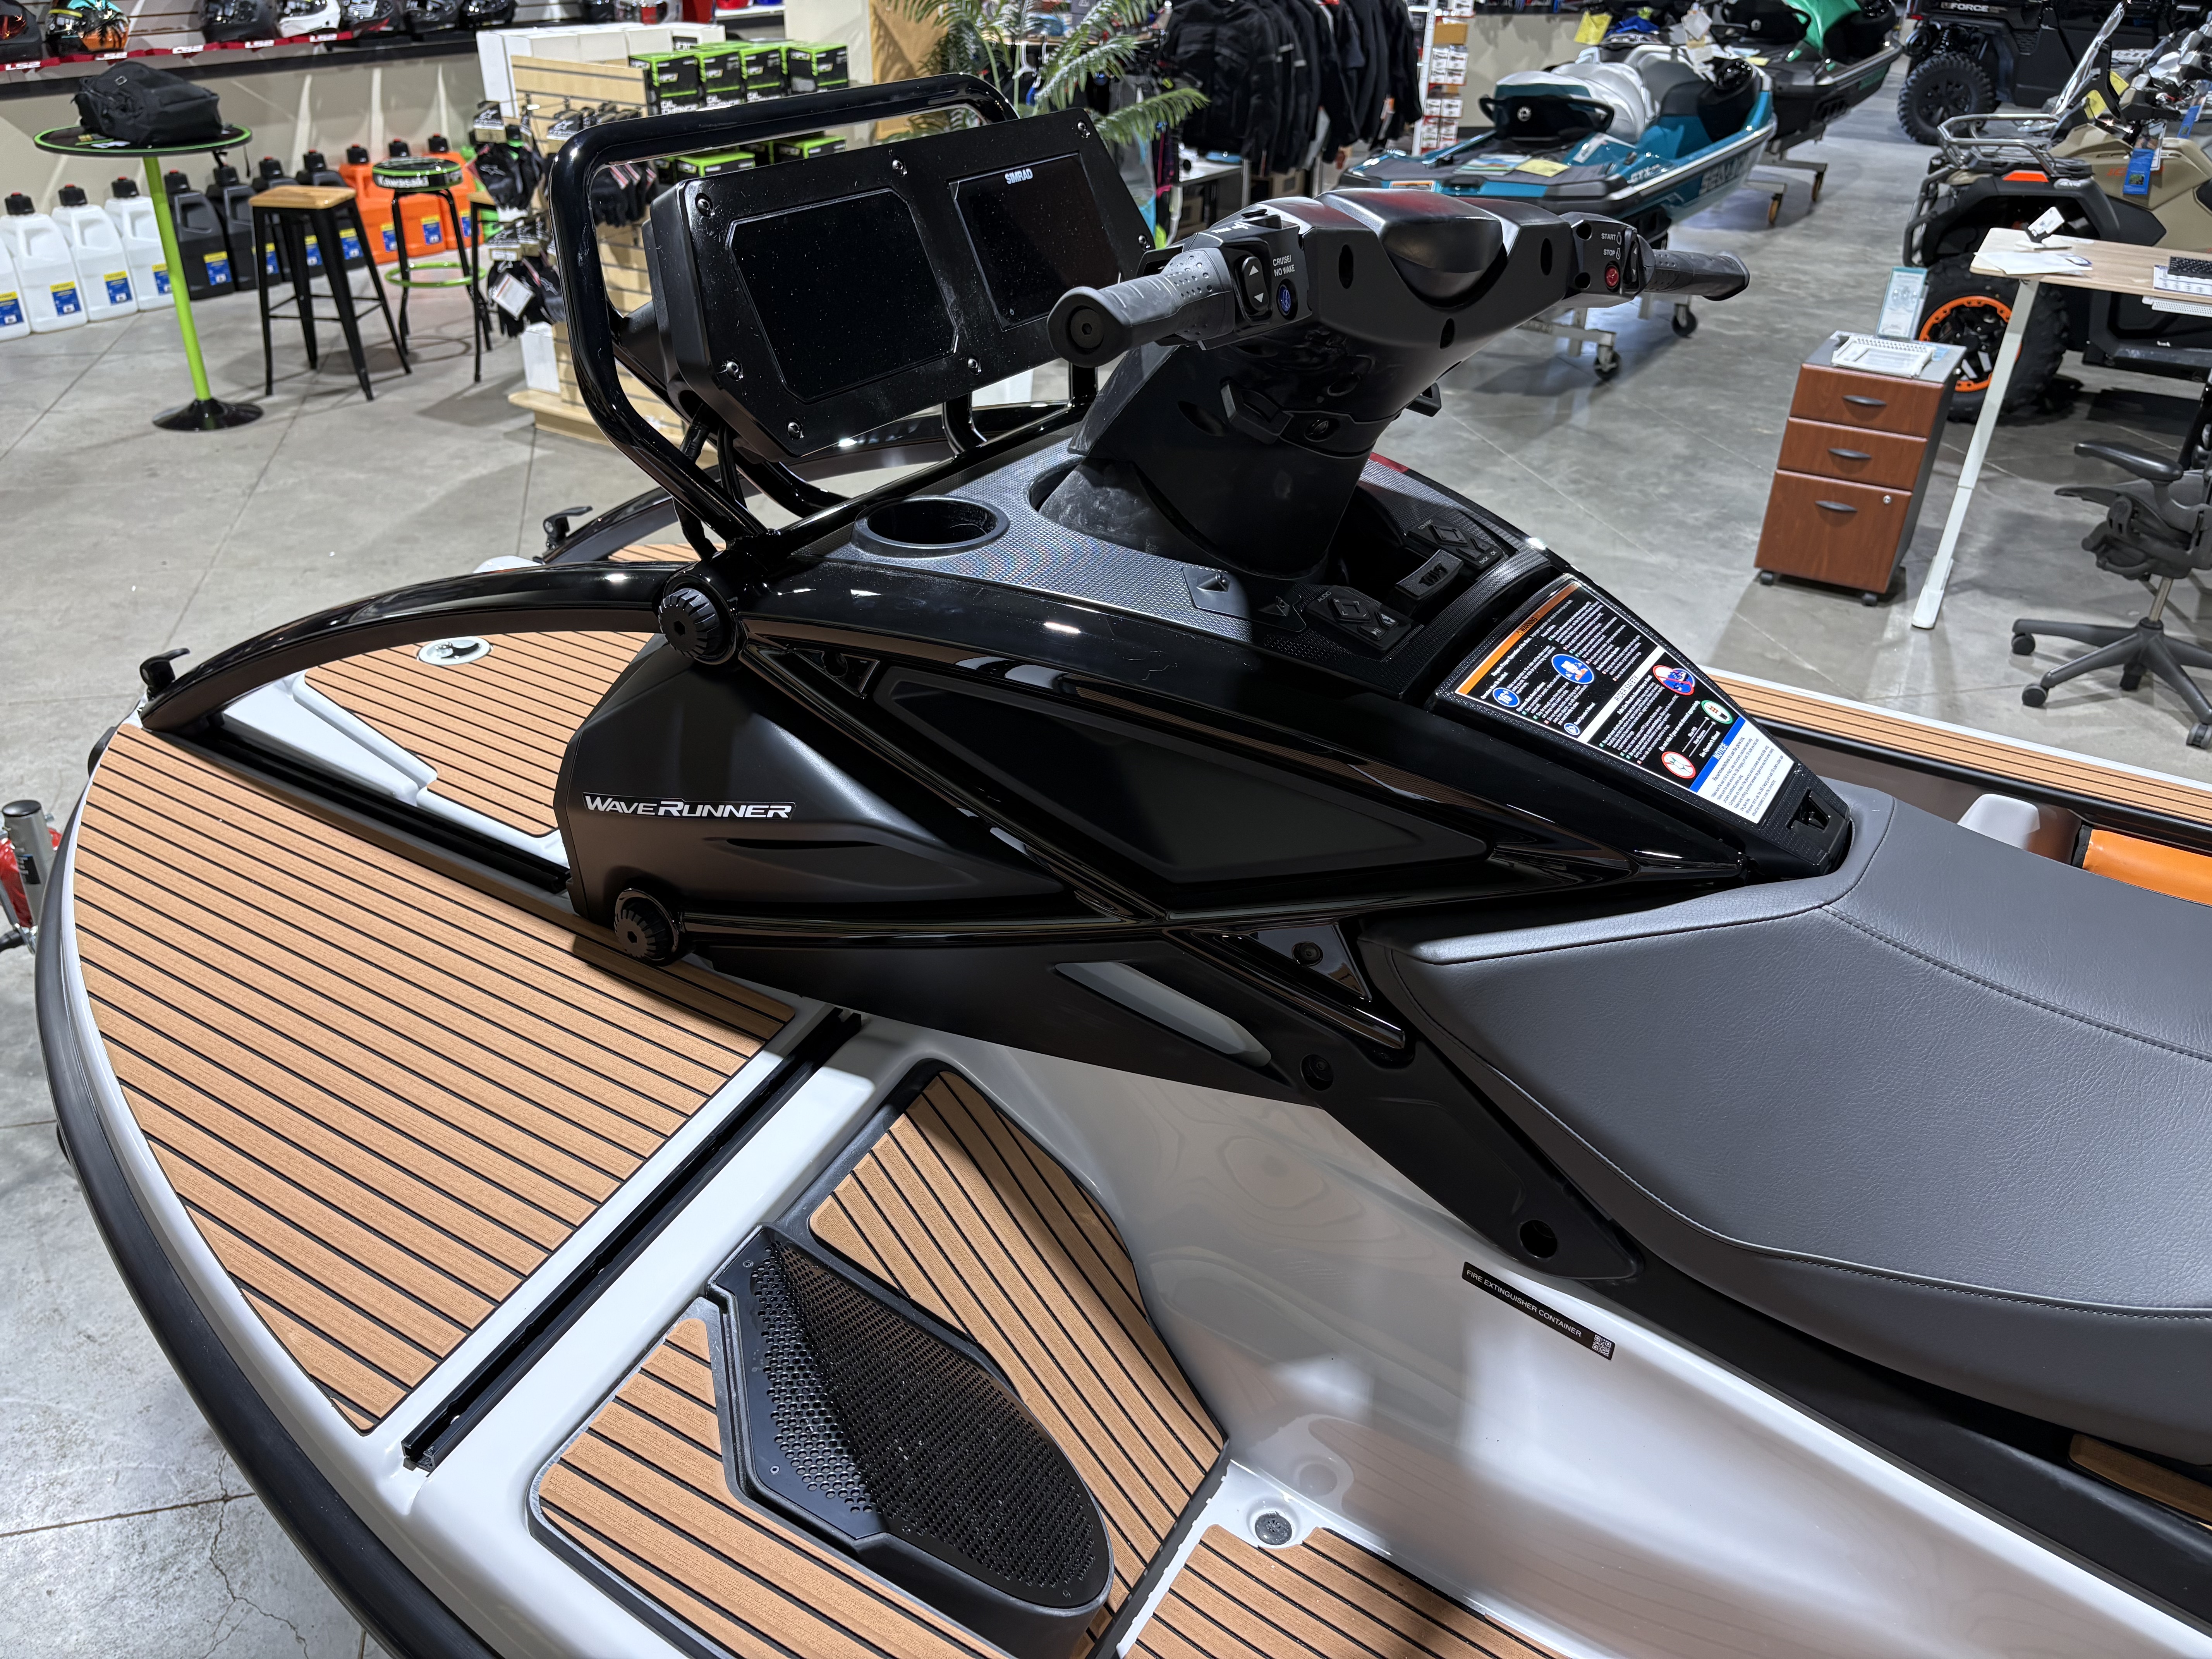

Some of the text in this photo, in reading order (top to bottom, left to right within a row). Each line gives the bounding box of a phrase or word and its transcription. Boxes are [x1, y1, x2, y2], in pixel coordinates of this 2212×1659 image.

[1005, 168, 1033, 184] SIMRAD
[1273, 254, 1291, 266] CRUISE/
[1274, 264, 1295, 277] NO WAKE
[1519, 616, 1538, 632] WARNING
[1490, 665, 1503, 677] Require
[1499, 658, 1511, 668] Proper
[1506, 647, 1522, 660] Operation
[1479, 687, 1493, 700] Operators
[1613, 688, 1628, 701] RIDER
[1624, 675, 1639, 690] SAFETY
[1496, 689, 1516, 705] 16+
[1529, 696, 1541, 707] constantly
[1625, 696, 1635, 705] Result
[1515, 700, 1528, 713] Operators
[1542, 701, 1552, 709] enough
[1586, 702, 1596, 711] Manual
[1664, 735, 1673, 743] ride
[1680, 712, 1691, 723] dressed
[1711, 730, 1721, 741] Manual
[1712, 742, 1729, 760] NOTICE
[1467, 1269, 1582, 1338] FIRE EXTINGUISHER CONTAINER
